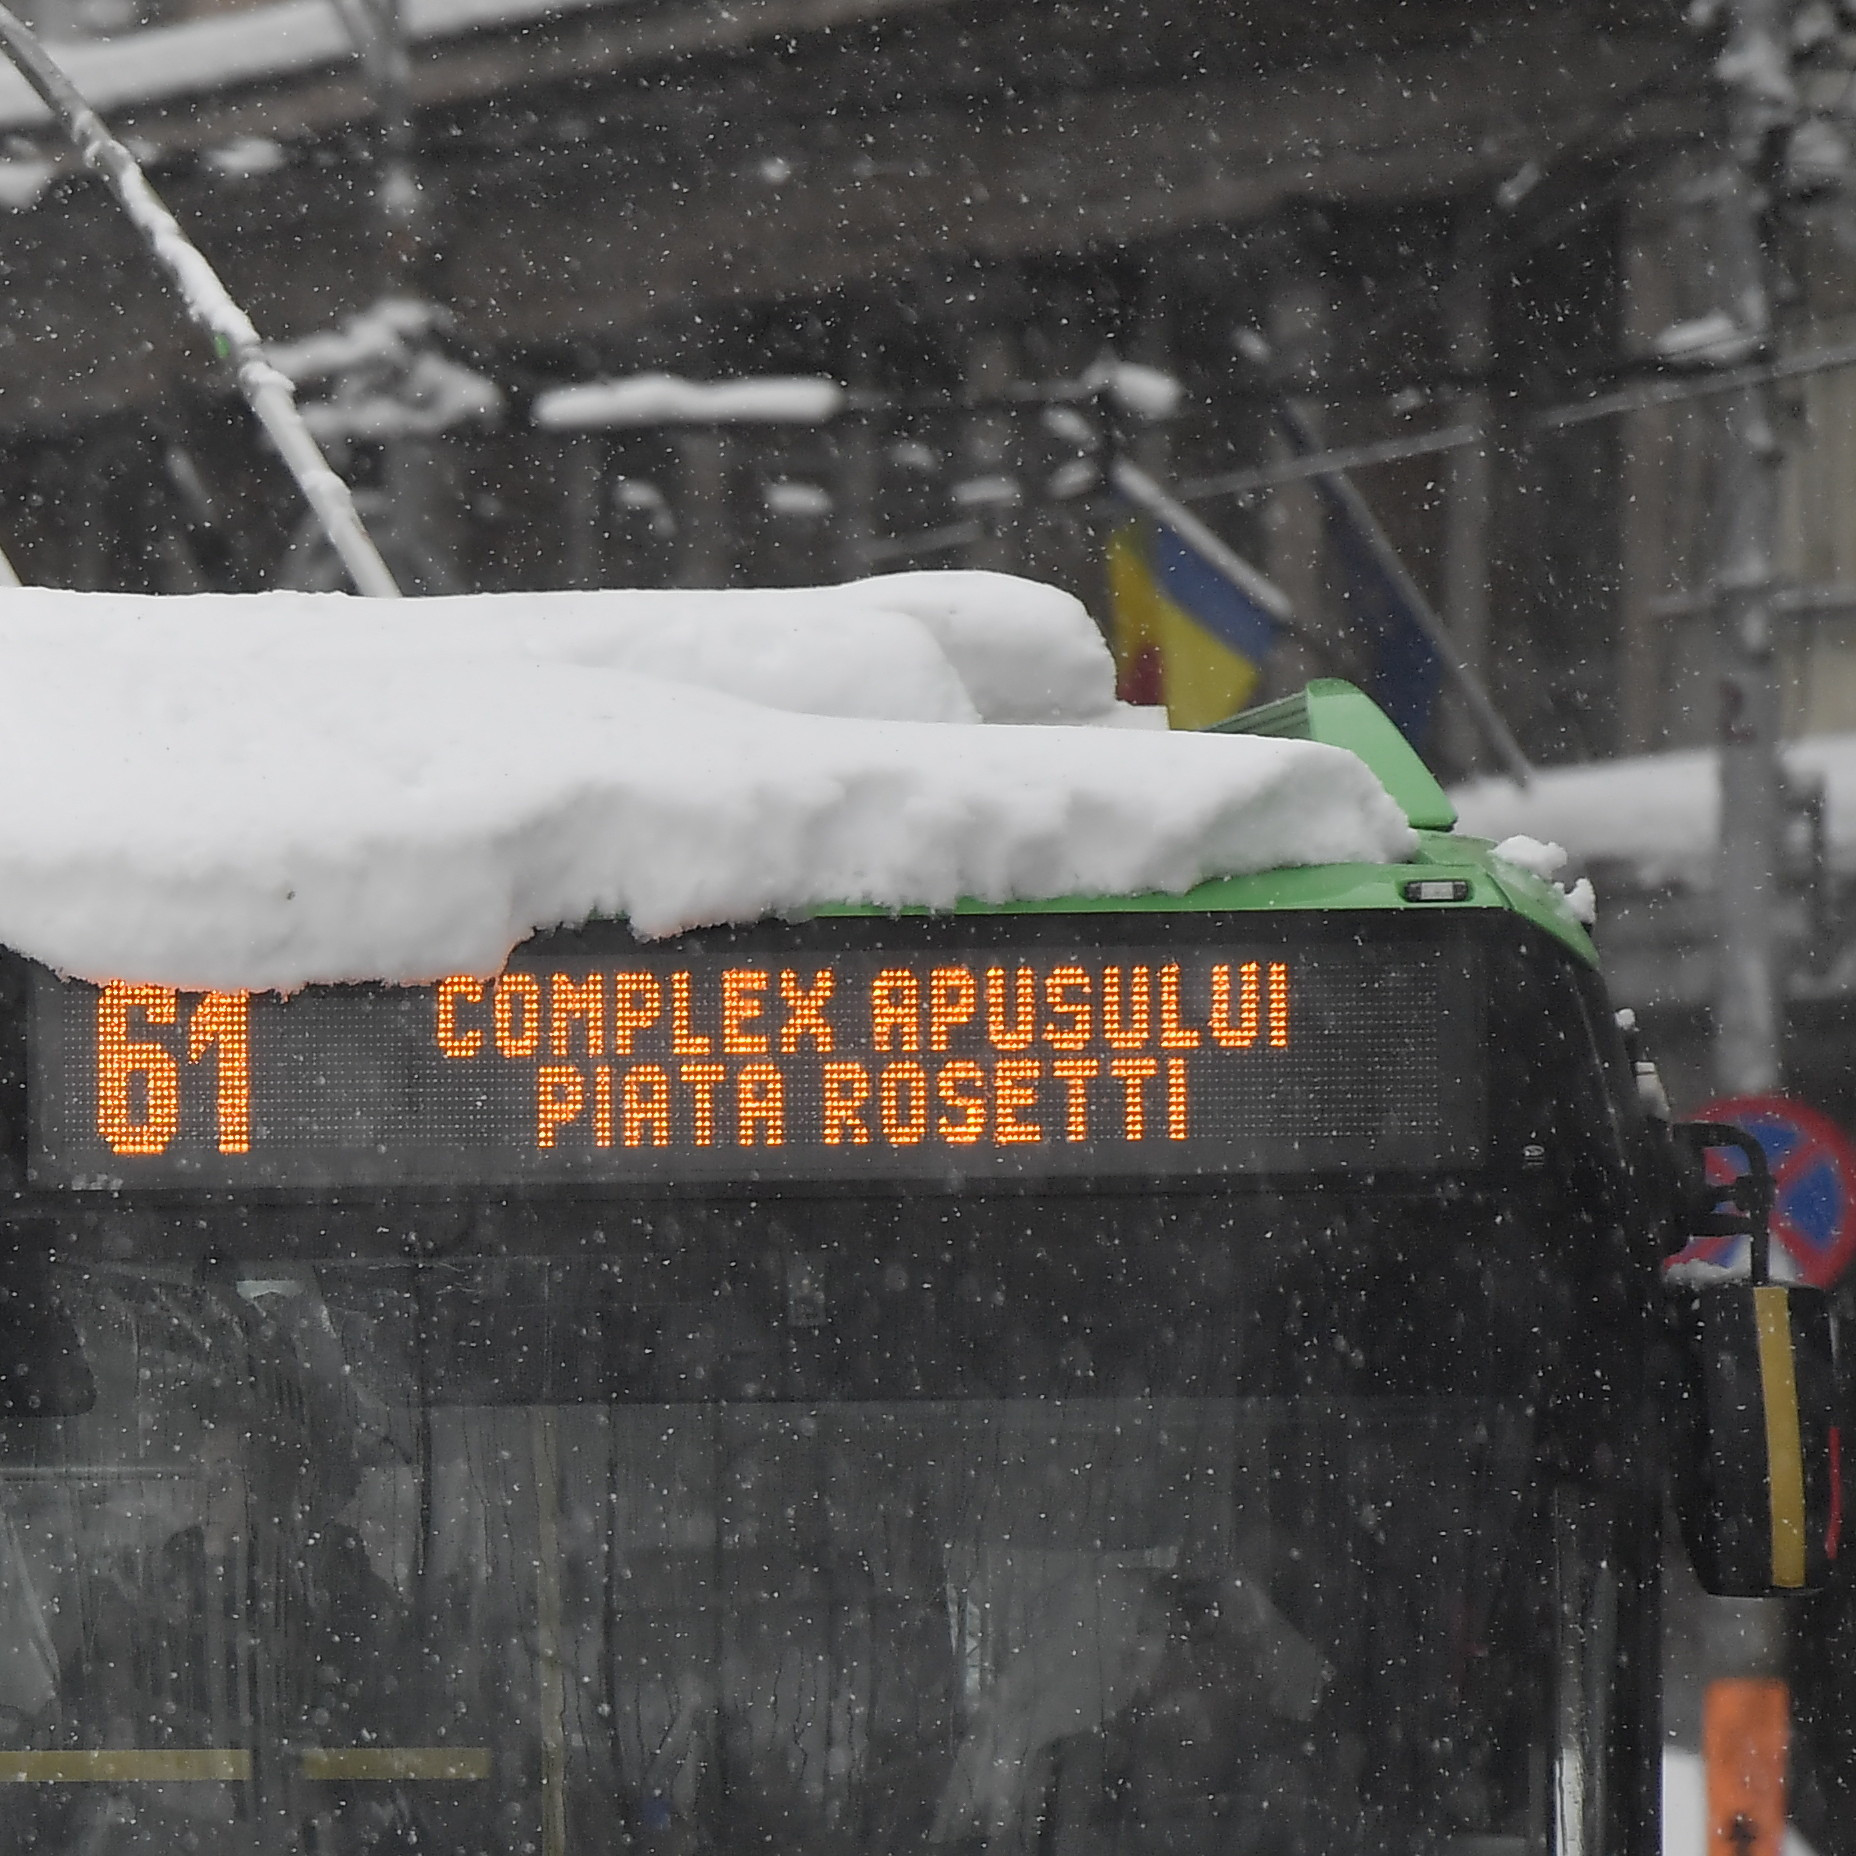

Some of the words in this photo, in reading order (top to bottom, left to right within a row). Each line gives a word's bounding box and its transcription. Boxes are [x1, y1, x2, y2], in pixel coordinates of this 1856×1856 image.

[437, 967, 835, 1058] COMPLEX
[871, 961, 1287, 1052] APUSULUI
[98, 979, 250, 1155] 61
[537, 1063, 784, 1148] PIATA
[822, 1058, 1189, 1145] ROSETTI
